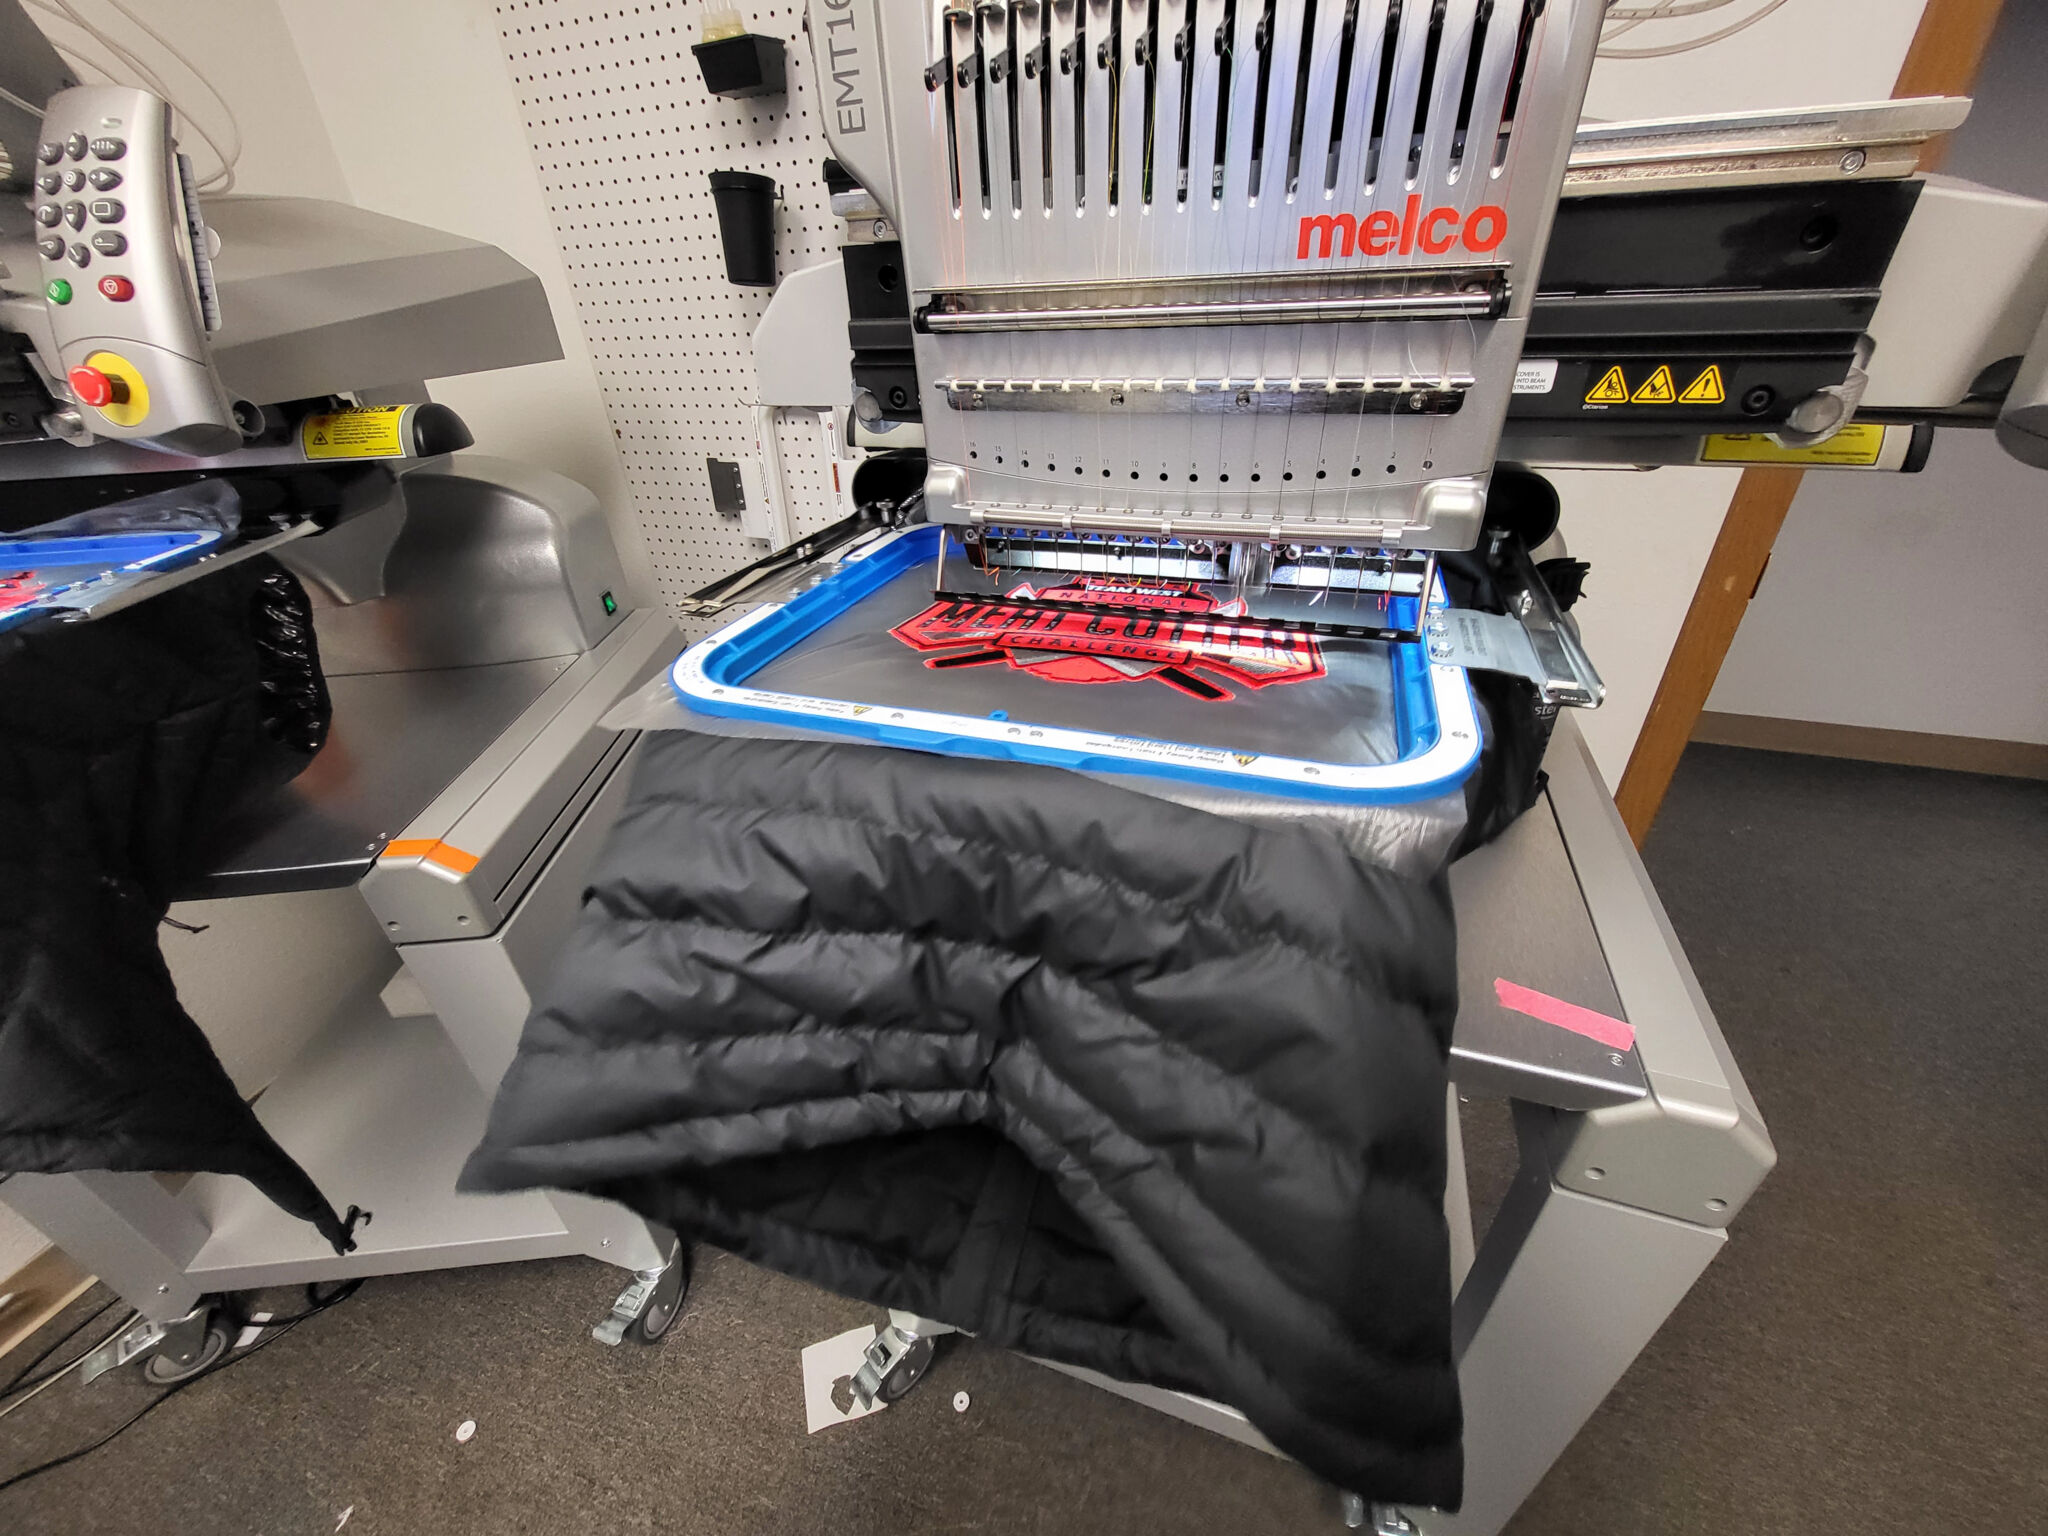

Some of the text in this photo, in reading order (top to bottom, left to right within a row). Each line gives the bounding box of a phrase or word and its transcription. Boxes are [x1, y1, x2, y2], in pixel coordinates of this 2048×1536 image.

[1297, 194, 1508, 259] melco
[1060, 592, 1189, 608] NATIONAL
[1087, 585, 1184, 597] TEAM WEST
[1011, 635, 1177, 659] CHALLENGE
